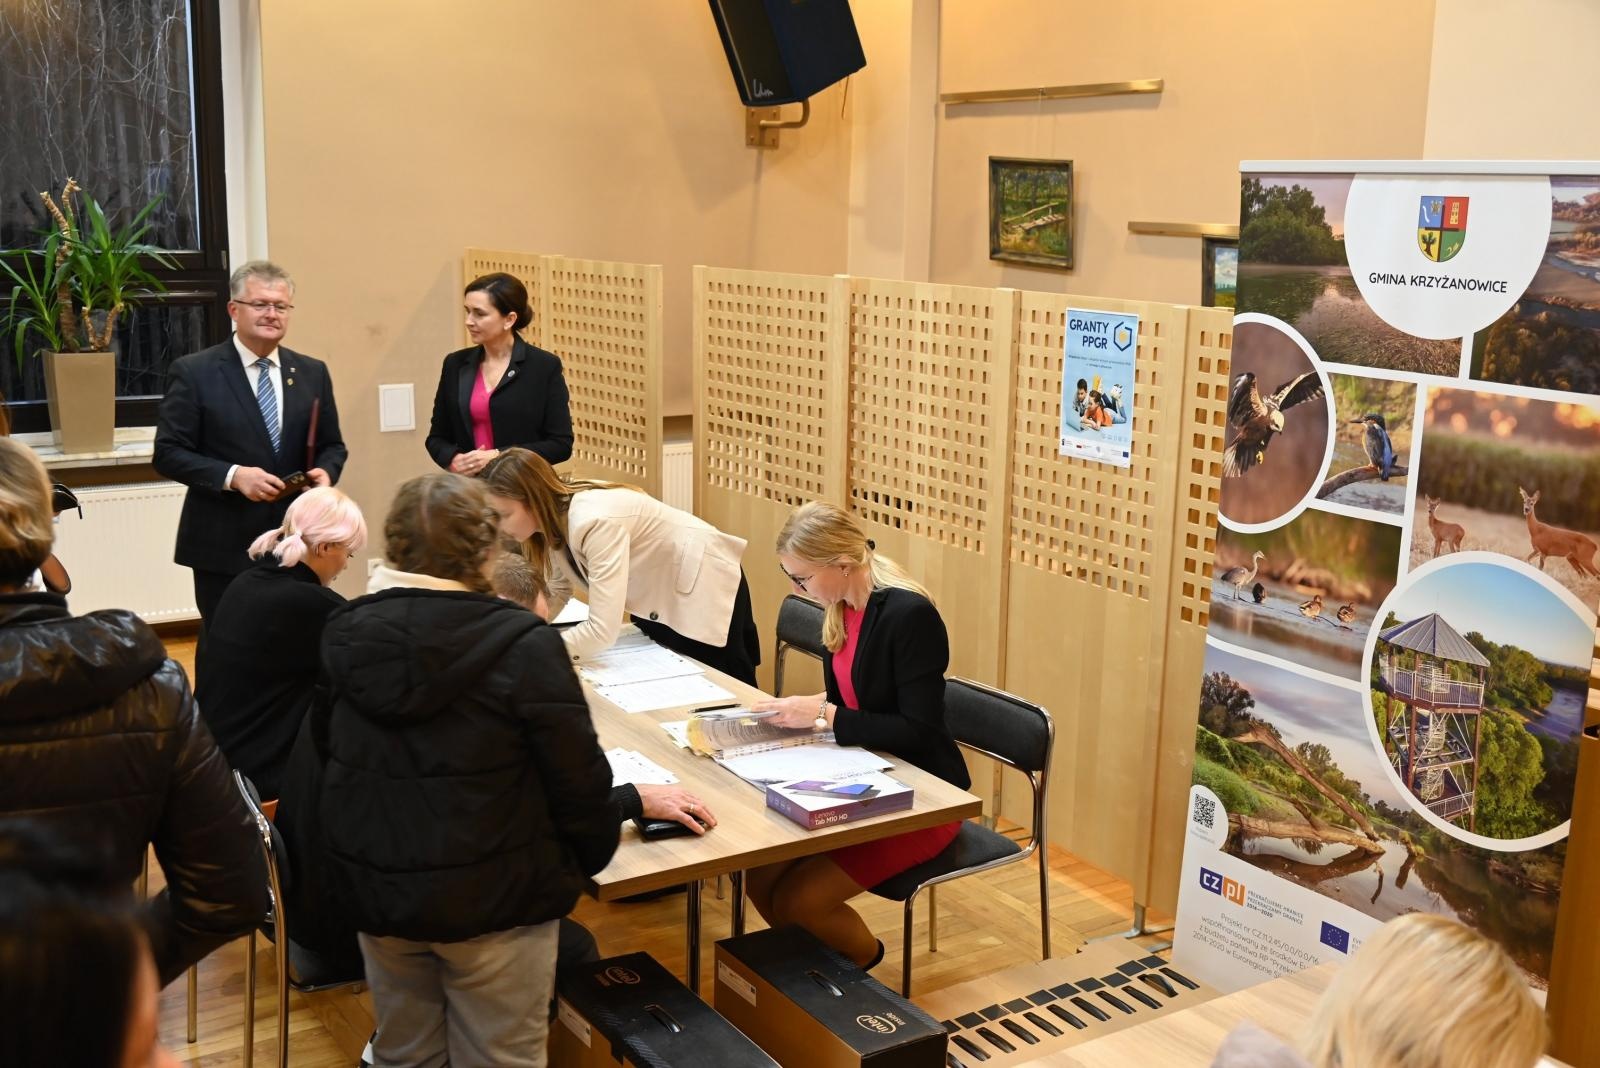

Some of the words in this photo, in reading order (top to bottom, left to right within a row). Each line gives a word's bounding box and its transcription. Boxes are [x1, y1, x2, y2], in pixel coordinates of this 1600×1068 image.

[1369, 272, 1406, 286] GMINA
[1410, 275, 1507, 293] KRZYŻANOWICE
[1069, 319, 1109, 334] GRANTY
[1082, 335, 1108, 350] PPGR
[814, 810, 836, 820] Lenovo
[815, 817, 825, 826] Tab
[826, 815, 838, 824] M10
[839, 813, 848, 822] HD
